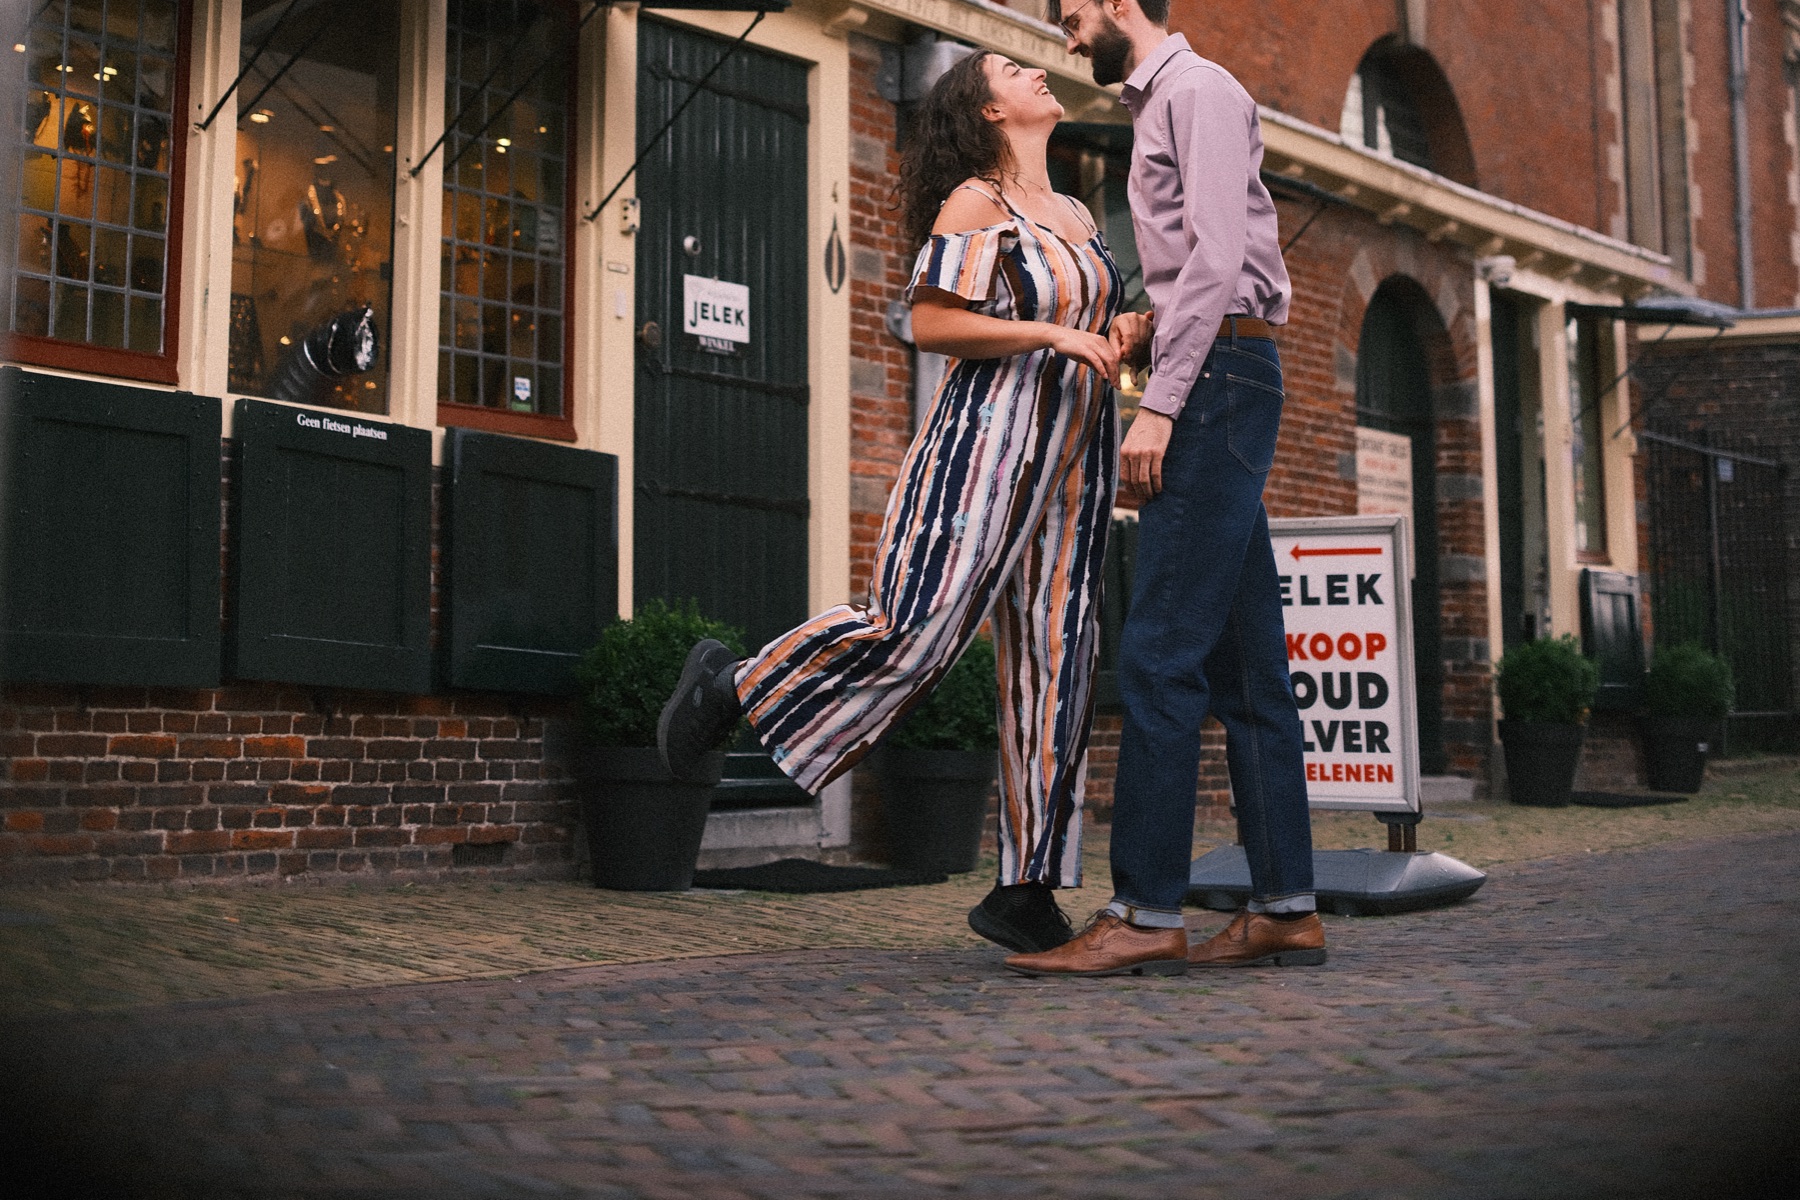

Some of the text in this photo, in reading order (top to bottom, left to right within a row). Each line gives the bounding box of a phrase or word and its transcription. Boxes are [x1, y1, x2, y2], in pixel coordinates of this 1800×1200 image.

[689, 301, 745, 328] JELEK
[297, 413, 388, 440] Geen fietsen plaatsen
[1278, 573, 1385, 606] ELEK
[1285, 632, 1387, 661] KOOP
[1289, 670, 1390, 710] OUD
[1299, 720, 1392, 754] LVER
[1305, 762, 1394, 783] ELENEN
